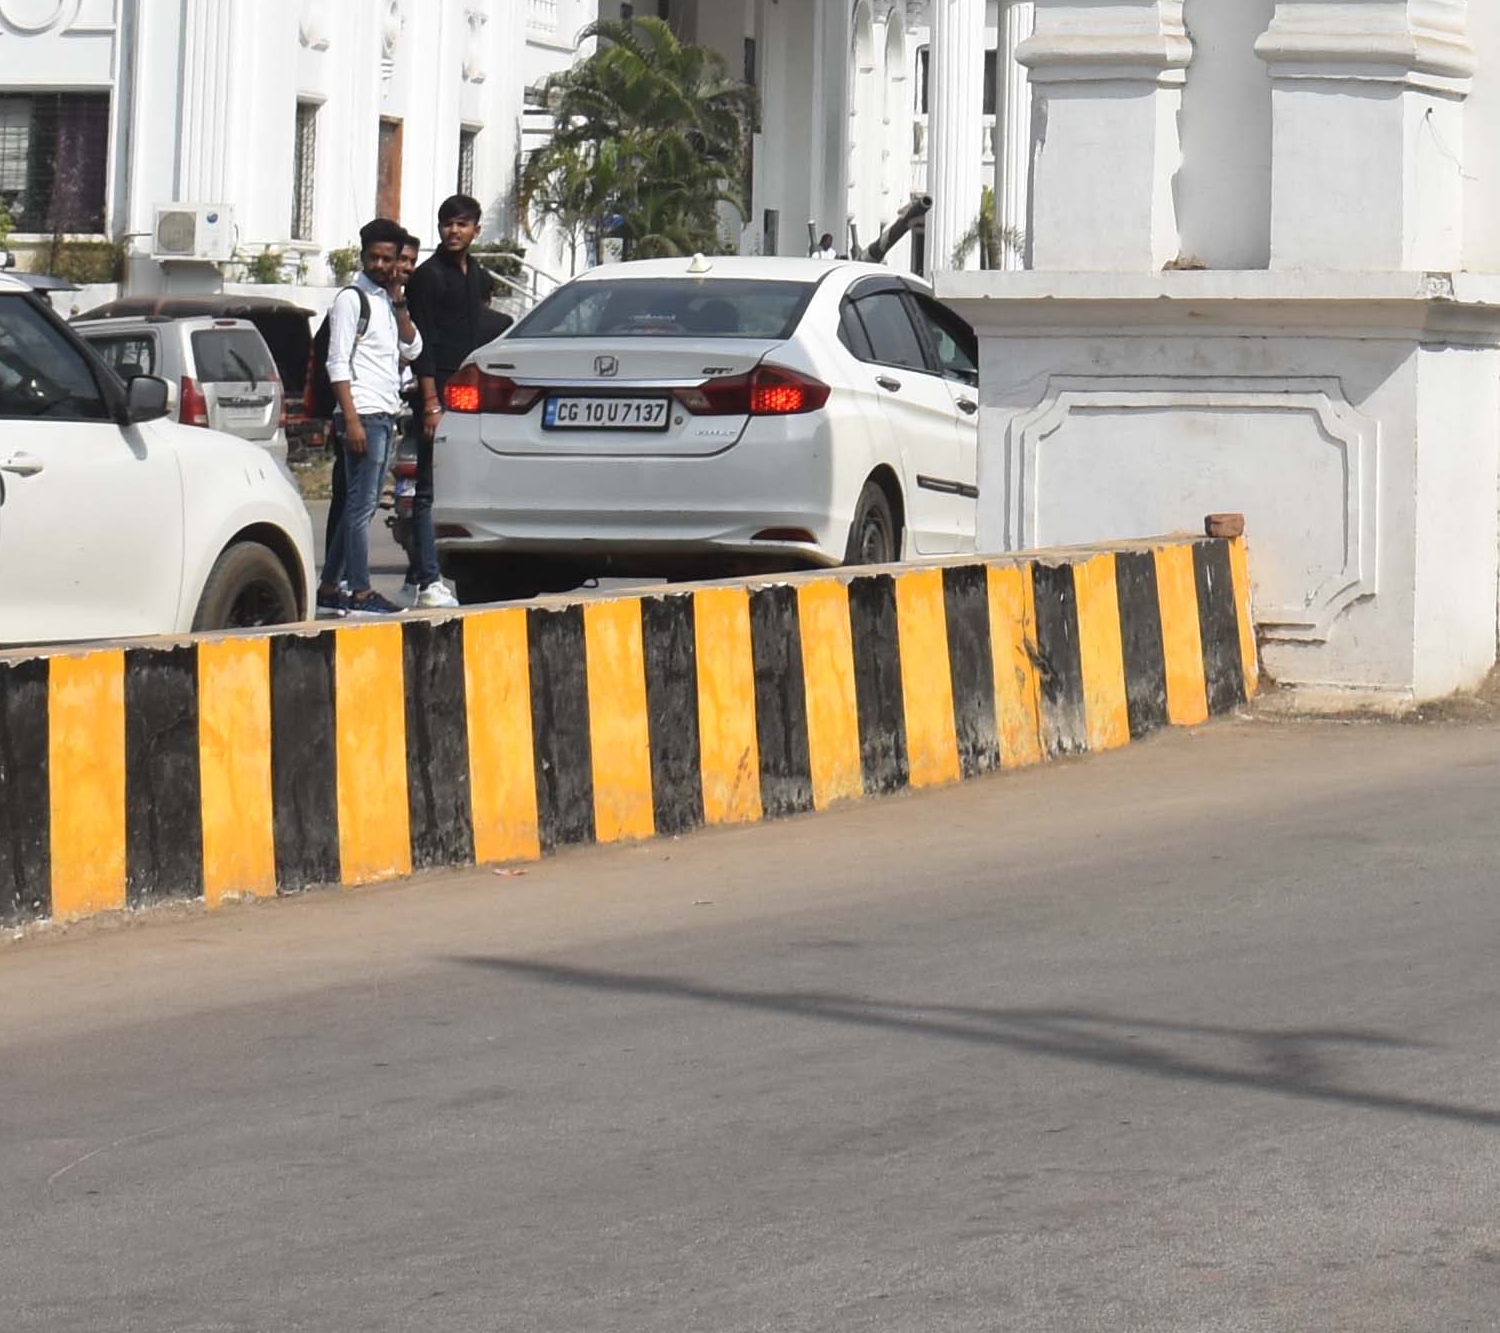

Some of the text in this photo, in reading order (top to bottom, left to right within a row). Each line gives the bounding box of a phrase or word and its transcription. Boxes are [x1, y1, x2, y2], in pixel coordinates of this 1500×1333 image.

[558, 403, 665, 422] CG 10 U 7137
